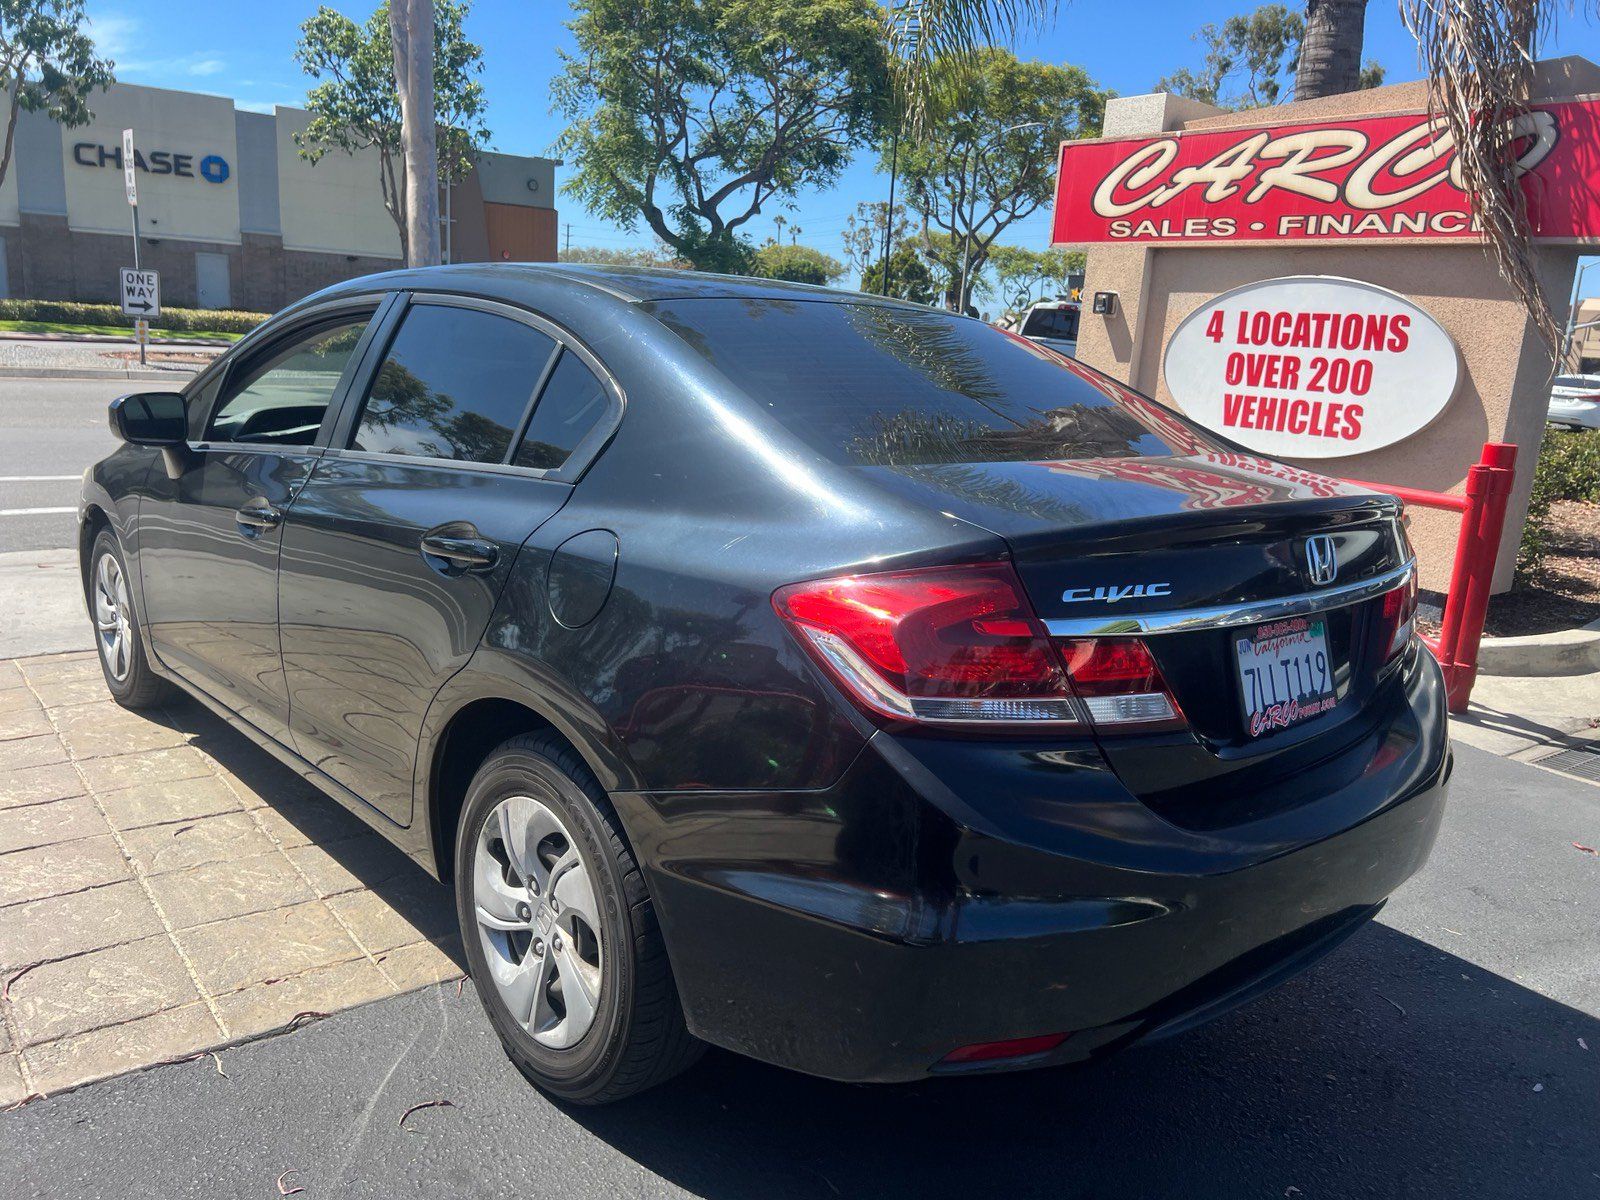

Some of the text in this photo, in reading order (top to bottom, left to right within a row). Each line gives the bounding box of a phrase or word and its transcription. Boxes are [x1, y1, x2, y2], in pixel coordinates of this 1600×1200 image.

[74, 143, 194, 178] CHASE
[1109, 217, 1236, 238] SALES
[126, 273, 154, 286] ONE
[126, 286, 155, 299] WAY
[1206, 310, 1411, 353] 4 LOCATIONS
[1225, 352, 1374, 396] OVER 200
[1223, 394, 1364, 441] VEHICLES
[1062, 583, 1172, 603] CIVIC
[1254, 633, 1312, 658] California
[1250, 700, 1298, 737] CARCO
